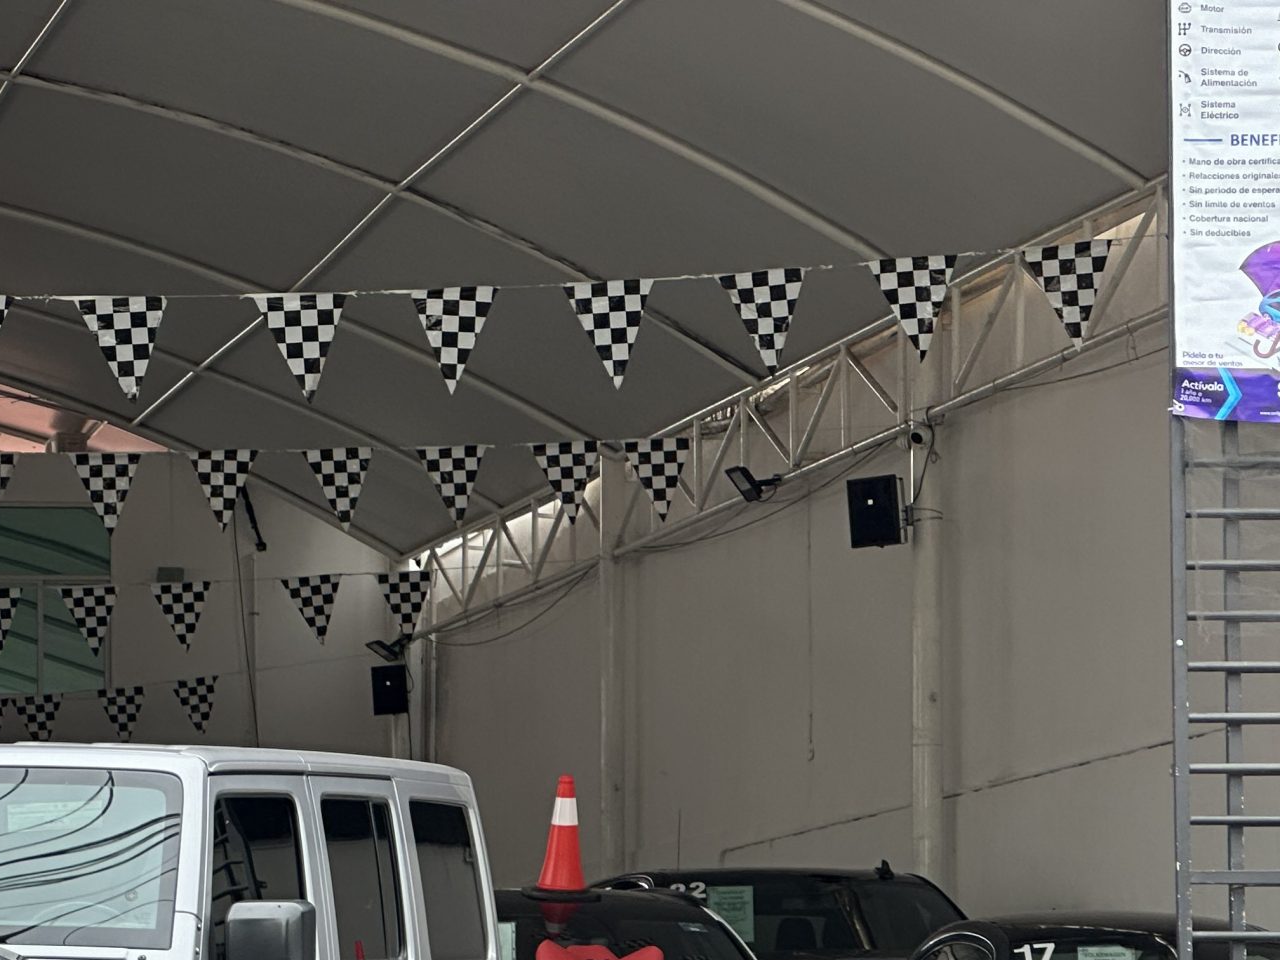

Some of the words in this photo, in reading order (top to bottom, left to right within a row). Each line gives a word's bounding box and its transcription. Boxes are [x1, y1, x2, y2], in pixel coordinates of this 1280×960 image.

[1200, 4, 1224, 13] Motor
[1200, 25, 1252, 35] Transmisión
[1200, 46, 1241, 56] Dirección
[1200, 67, 1236, 77] Sistema
[1237, 68, 1249, 77] de
[1200, 78, 1258, 87] Alimentación
[1200, 101, 1236, 109] Sistema
[1200, 111, 1239, 120] Eléctrico
[1188, 158, 1212, 166] Mano
[1213, 158, 1225, 166] de
[1226, 158, 1246, 166] obra
[1188, 186, 1203, 194] Sin
[1238, 186, 1250, 195] de
[1188, 200, 1203, 208] Sin
[1189, 215, 1231, 223] Cobertura
[1233, 215, 1269, 223] nacional
[1190, 229, 1204, 237] Sin
[1181, 379, 1224, 392] Actívala
